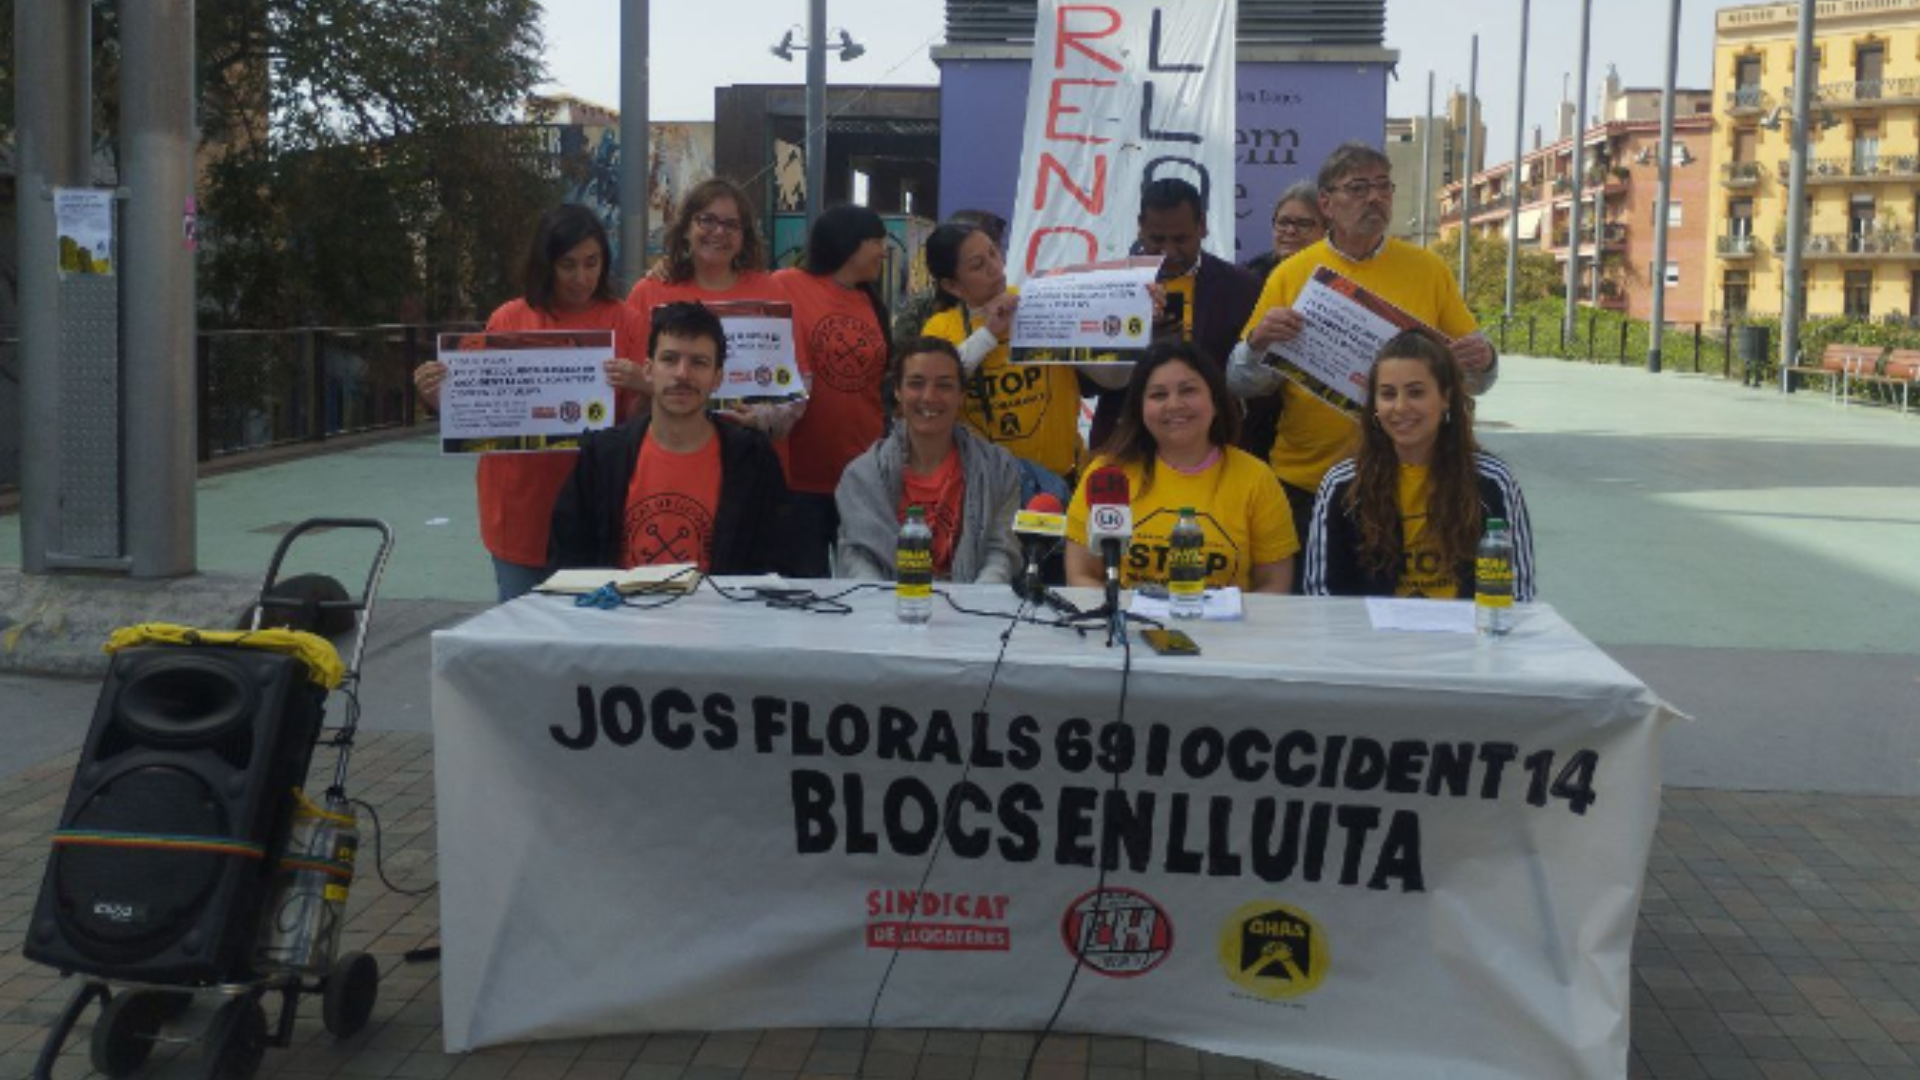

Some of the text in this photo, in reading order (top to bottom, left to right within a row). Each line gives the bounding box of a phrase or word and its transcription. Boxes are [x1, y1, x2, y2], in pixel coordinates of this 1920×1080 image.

[966, 366, 1042, 399] STOP
[1129, 543, 1228, 577] STP
[548, 684, 739, 751] JOCS
[752, 695, 1042, 770] FLORALS
[1054, 717, 1136, 774] 69
[1179, 723, 1519, 799] OCCIDENT
[1523, 748, 1600, 816] 14
[790, 768, 1426, 893] BLOCS EN LLUITA
[866, 889, 1011, 919] SINDICAT
[873, 926, 897, 942] DE
